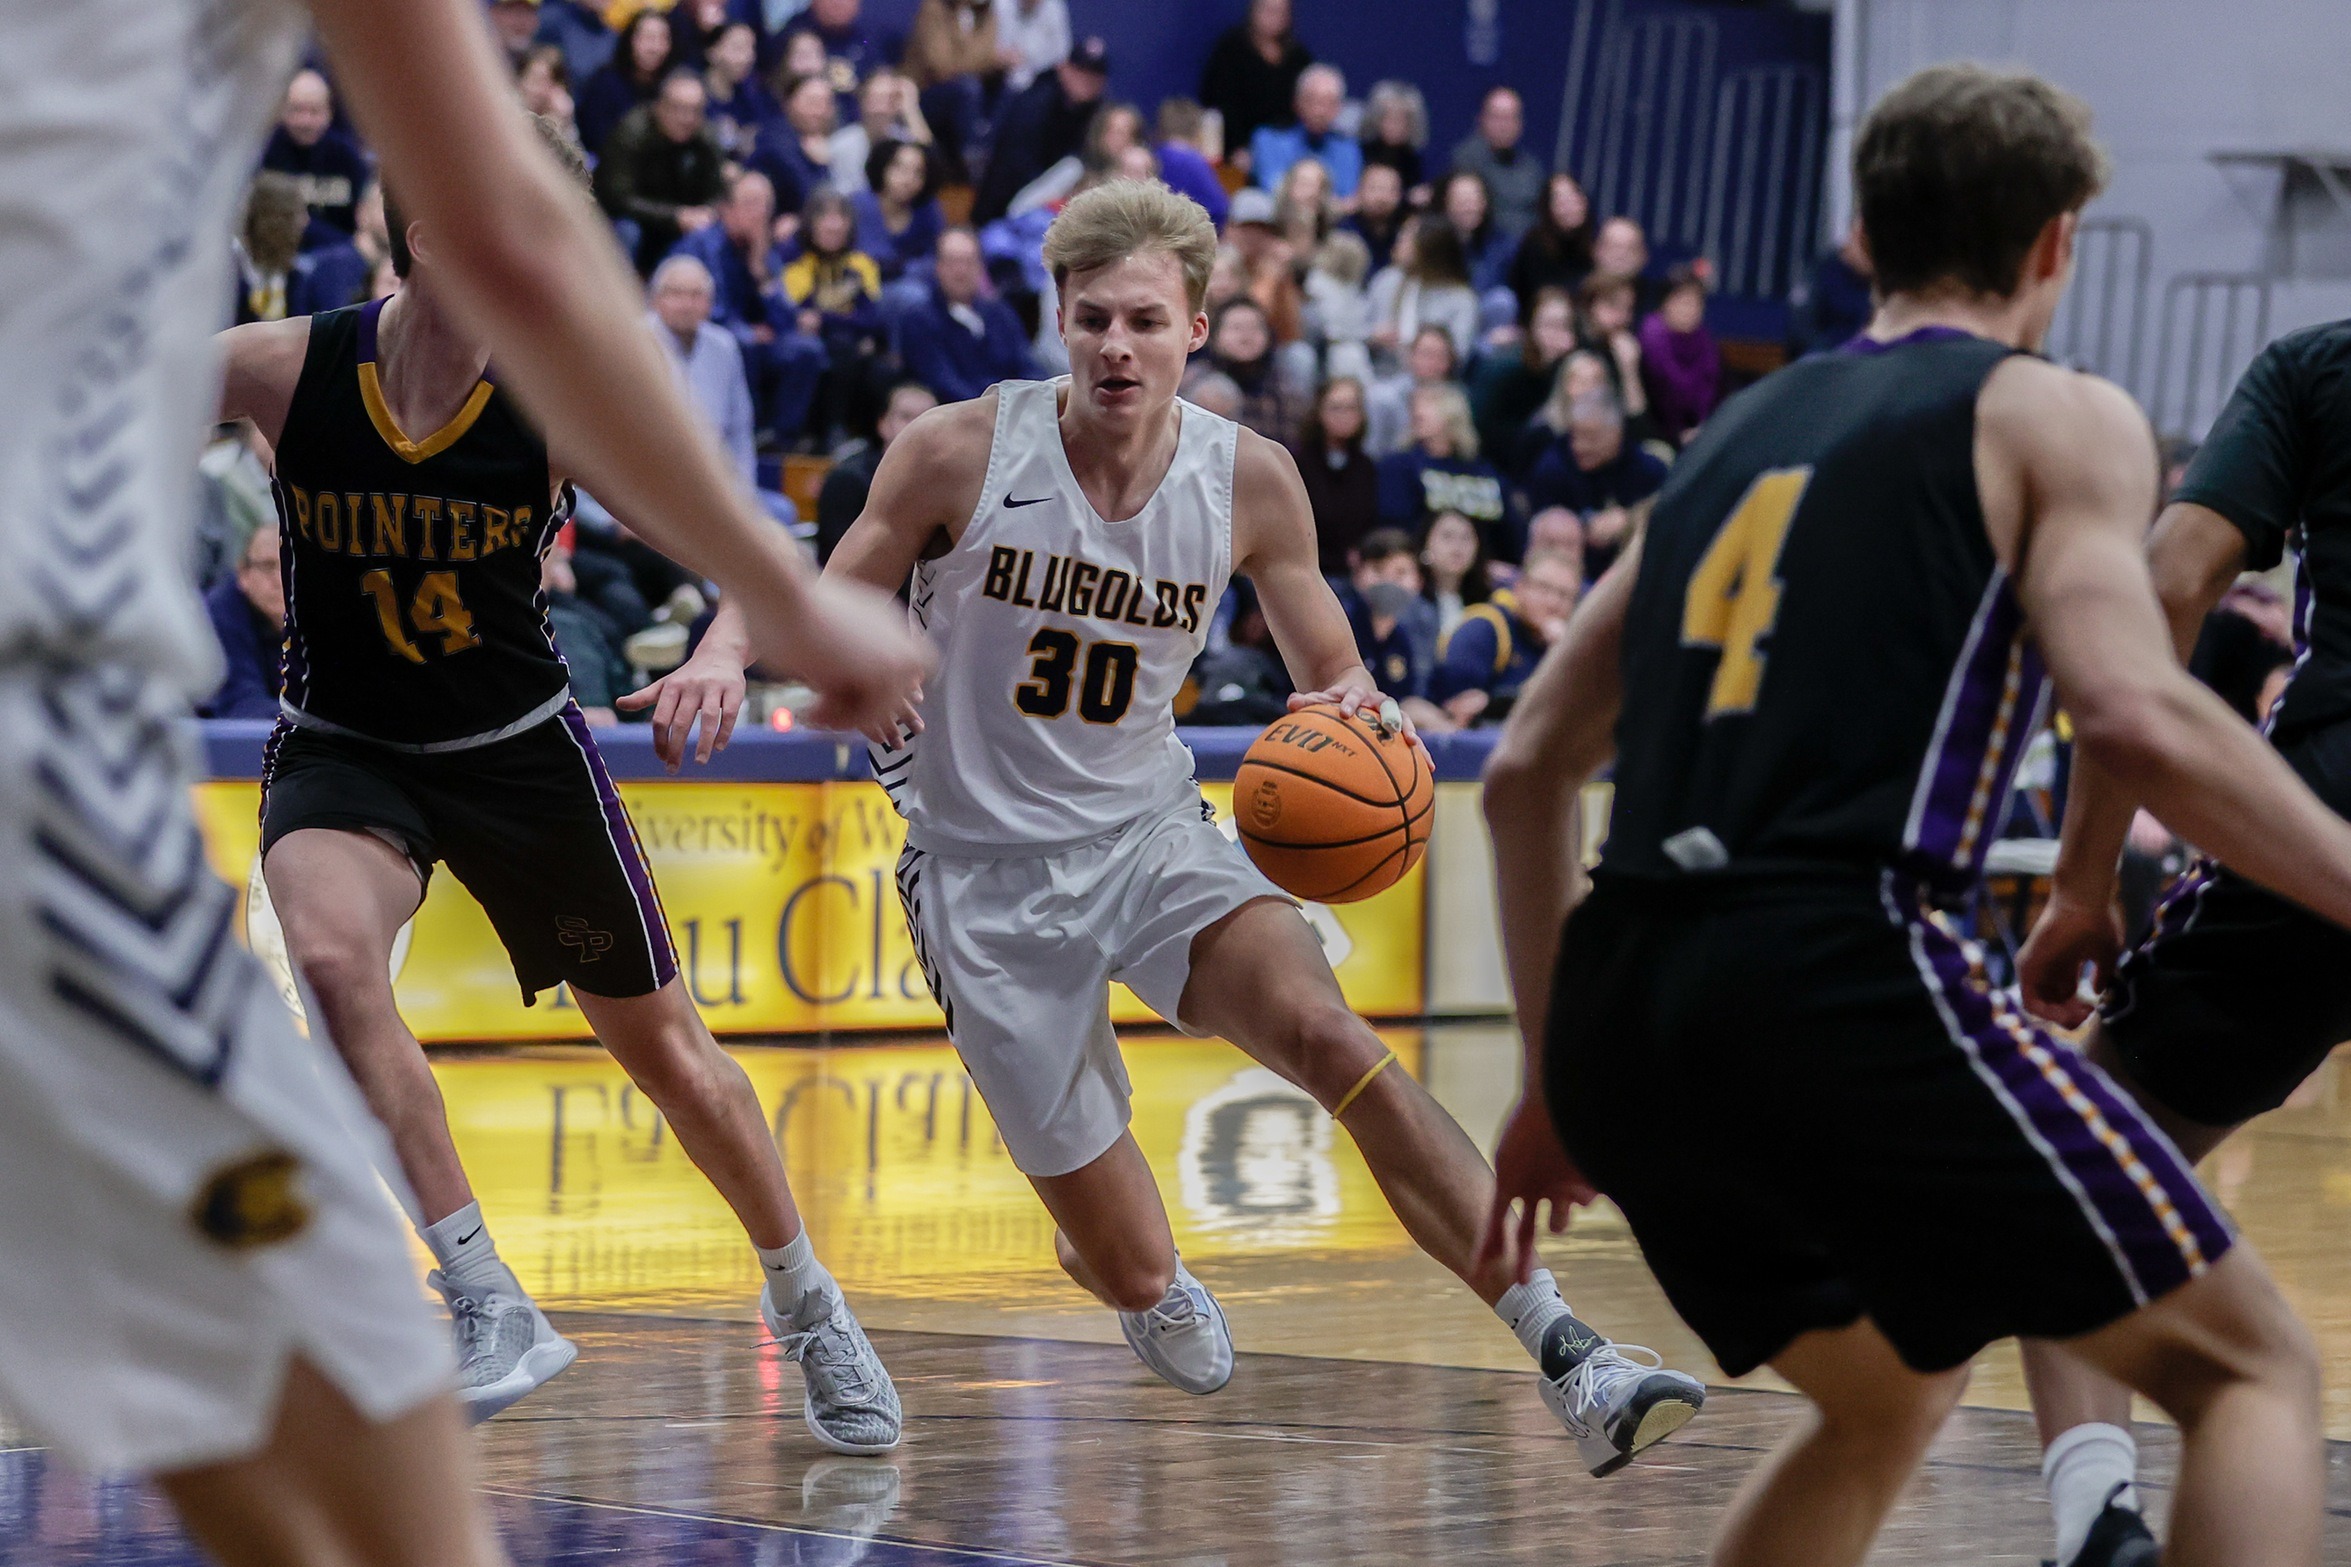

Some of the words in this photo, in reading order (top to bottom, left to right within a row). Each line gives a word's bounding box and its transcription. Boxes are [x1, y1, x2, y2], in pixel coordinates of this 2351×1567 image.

[359, 567, 483, 665] 14
[982, 543, 1207, 634] BLUGOLDS
[1680, 463, 1815, 725] 4
[1013, 626, 1140, 727] 30
[1331, 741, 1356, 758] NXT
[631, 799, 799, 874] iversity
